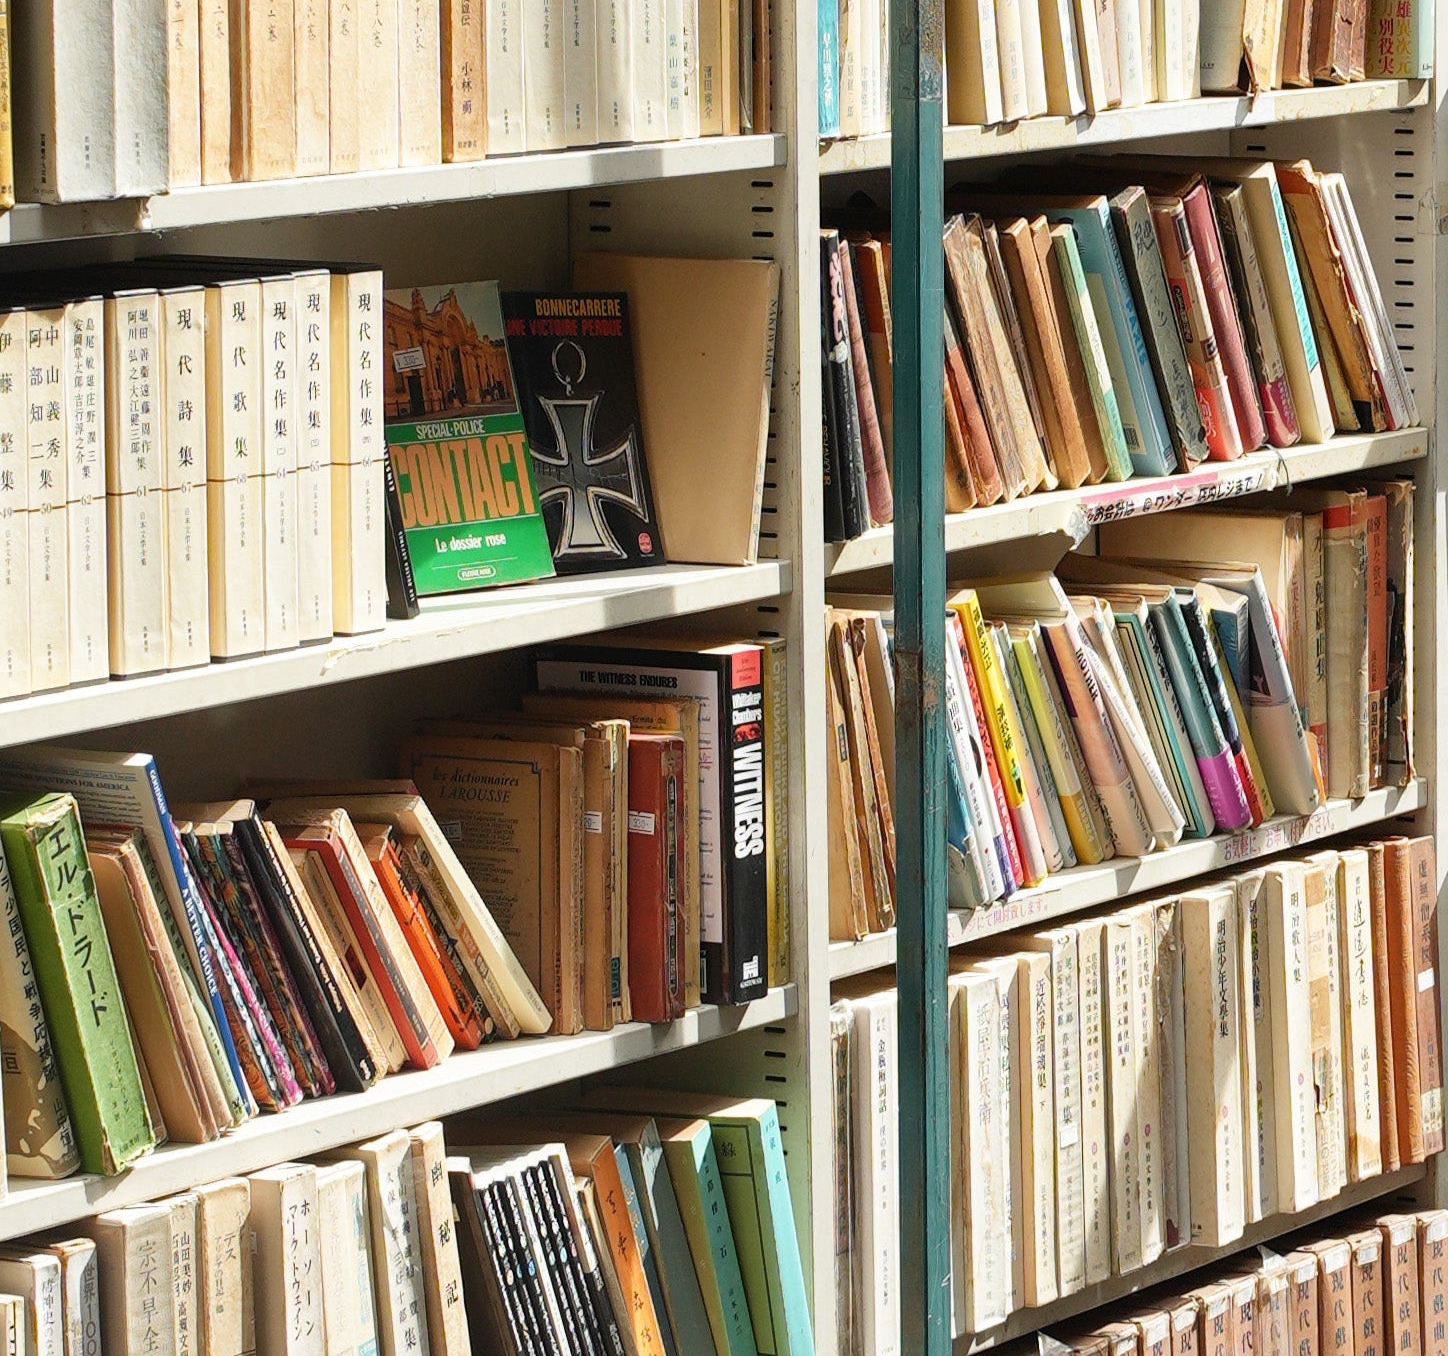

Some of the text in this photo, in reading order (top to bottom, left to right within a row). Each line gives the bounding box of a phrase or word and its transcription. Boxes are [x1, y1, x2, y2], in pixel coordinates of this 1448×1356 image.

[272, 300, 289, 439] 現代名作集
[306, 293, 322, 431] 現代名作集
[357, 293, 374, 427] 現代名作集
[534, 298, 623, 318] BONNECARRERE
[28, 328, 45, 461] 阿部知二
[45, 325, 62, 461] 中山義秀
[176, 308, 194, 468] 現代詩集
[232, 301, 250, 459] 現代歌集
[39, 468, 54, 490] 集
[390, 435, 539, 528] CONTACT
[434, 532, 507, 554] Le dossier rose
[579, 670, 679, 689] THE WITNESS ENDURES
[439, 786, 511, 804] LAROUSSE
[450, 767, 521, 787] dictionnaires
[731, 741, 765, 860] WITNESS
[46, 825, 109, 1028] エル・ドラード
